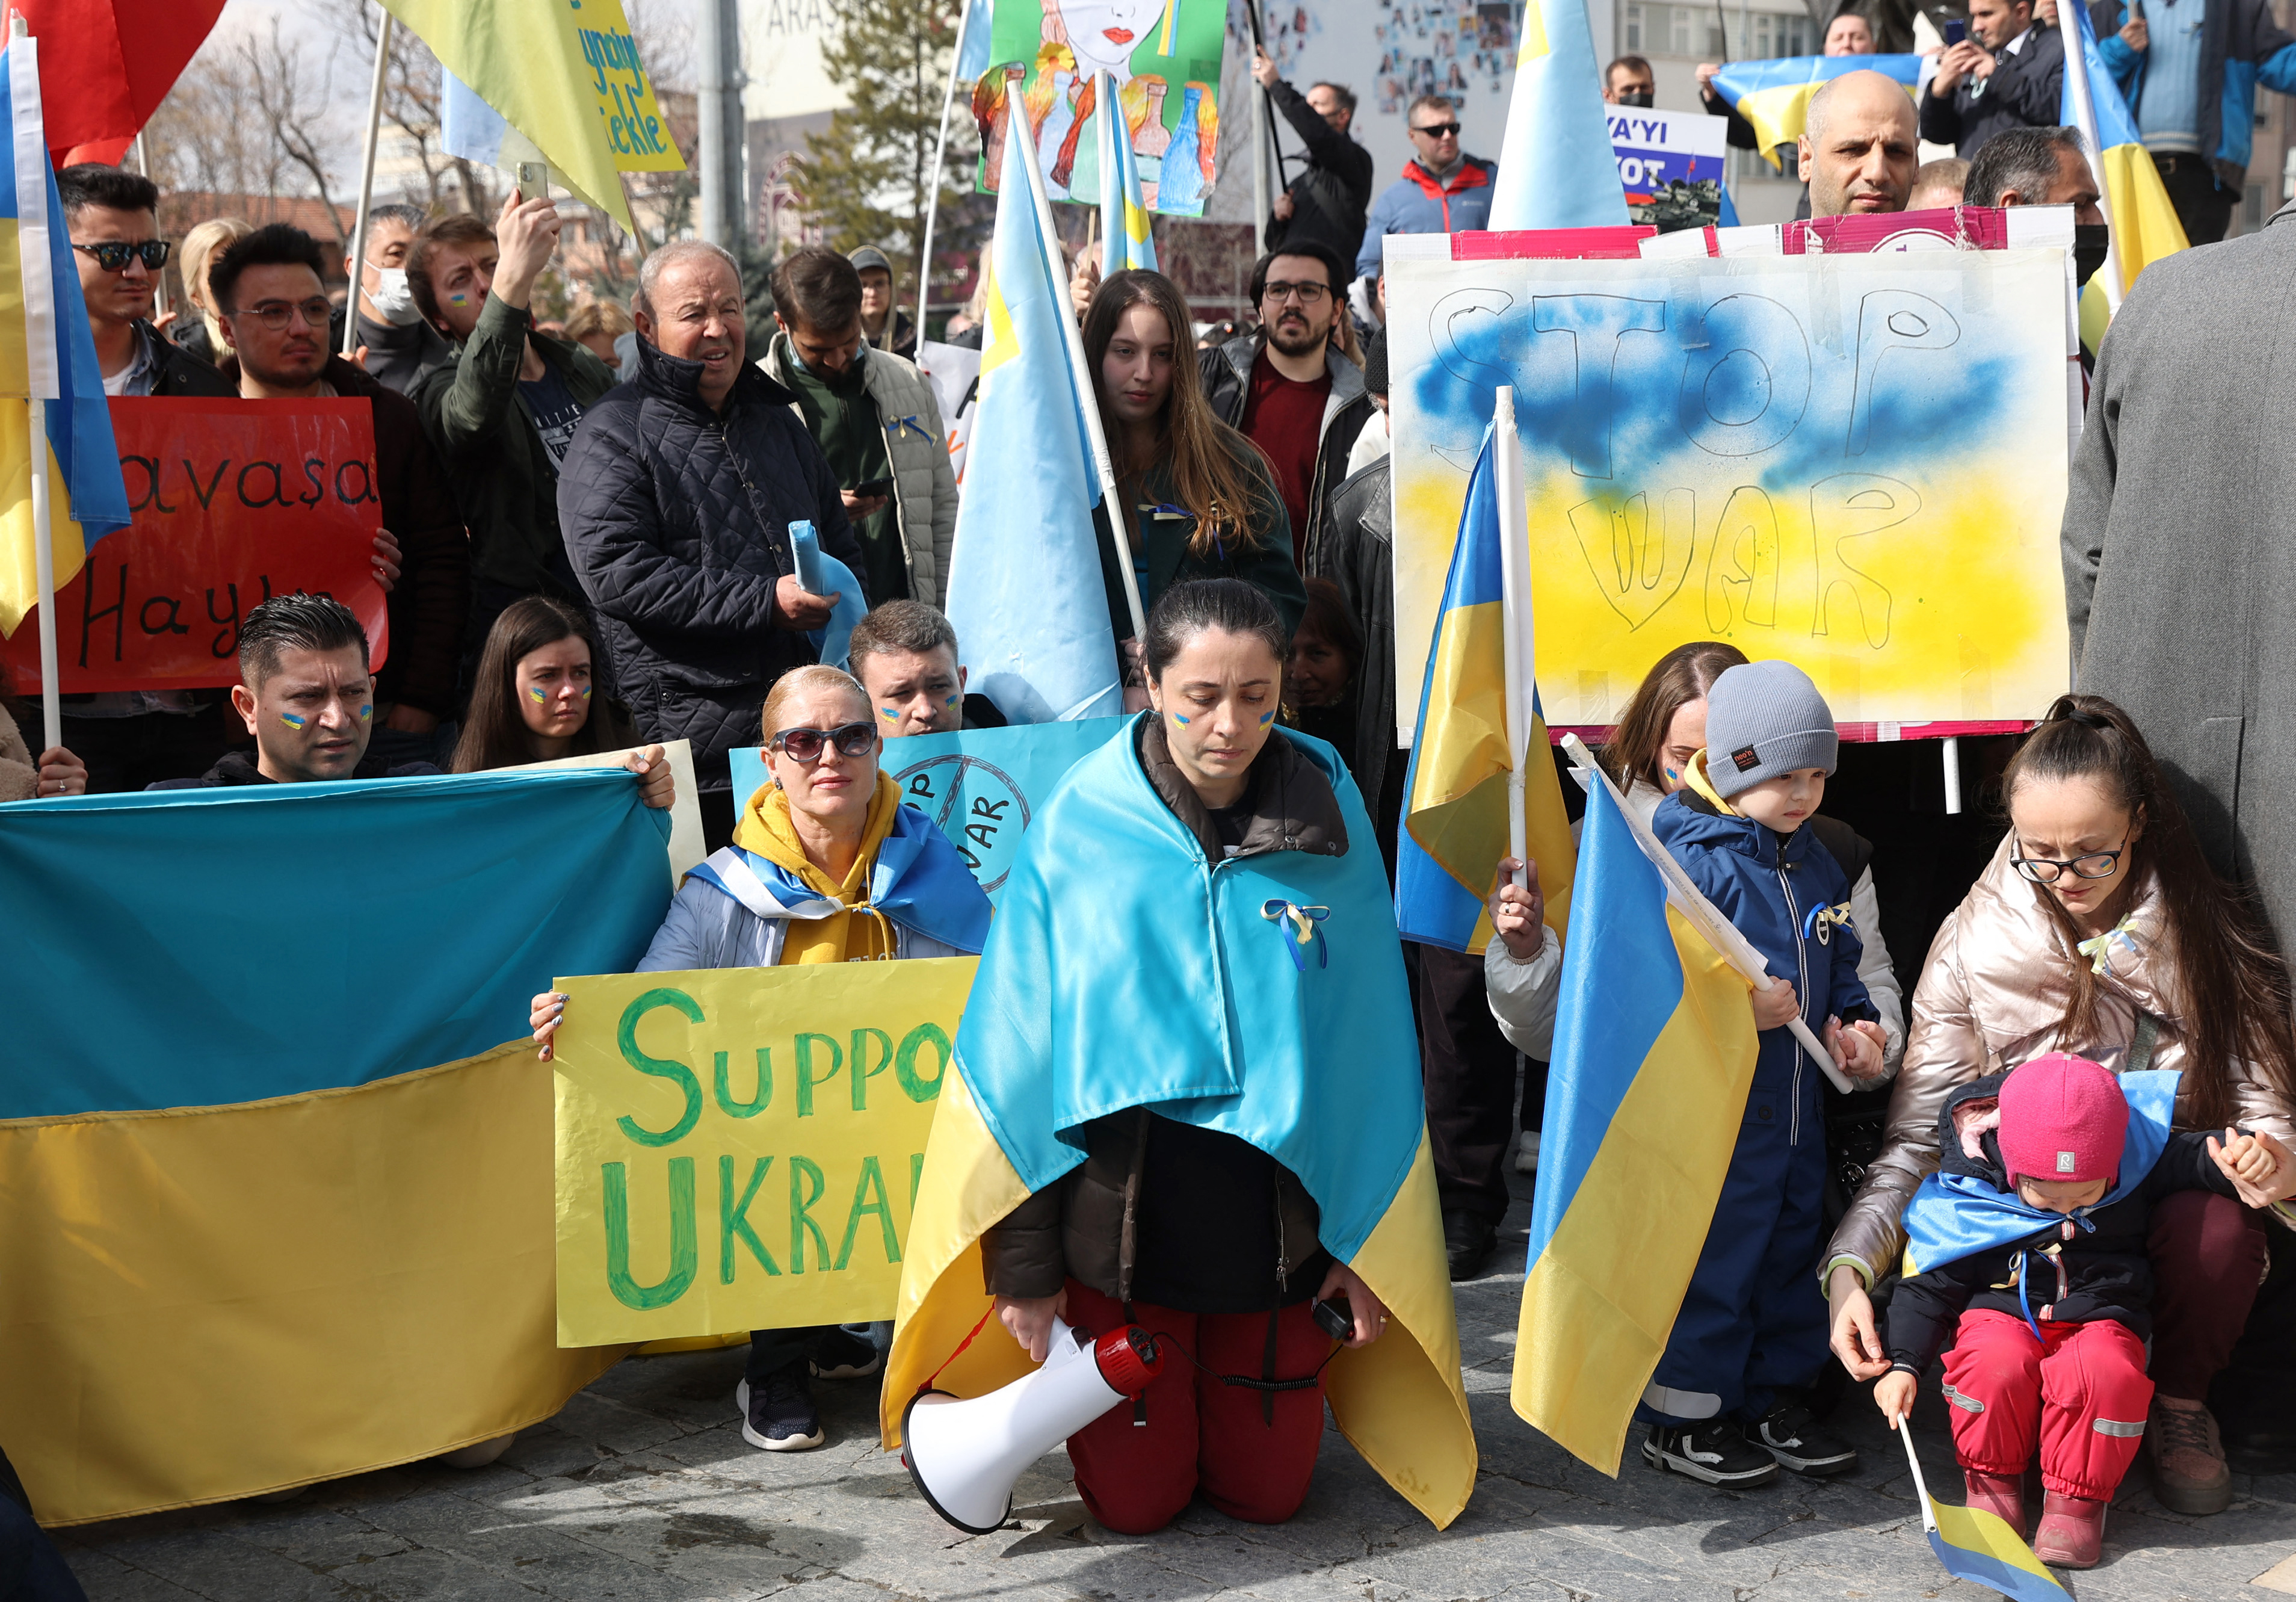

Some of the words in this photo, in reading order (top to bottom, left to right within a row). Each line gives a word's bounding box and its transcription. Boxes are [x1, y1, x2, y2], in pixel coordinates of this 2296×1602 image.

[1616, 155, 1666, 188] OT
[1429, 287, 1961, 480] STOP
[78, 555, 330, 669] Hay
[1567, 472, 1922, 649] WAR
[616, 987, 963, 1148] SUPPO
